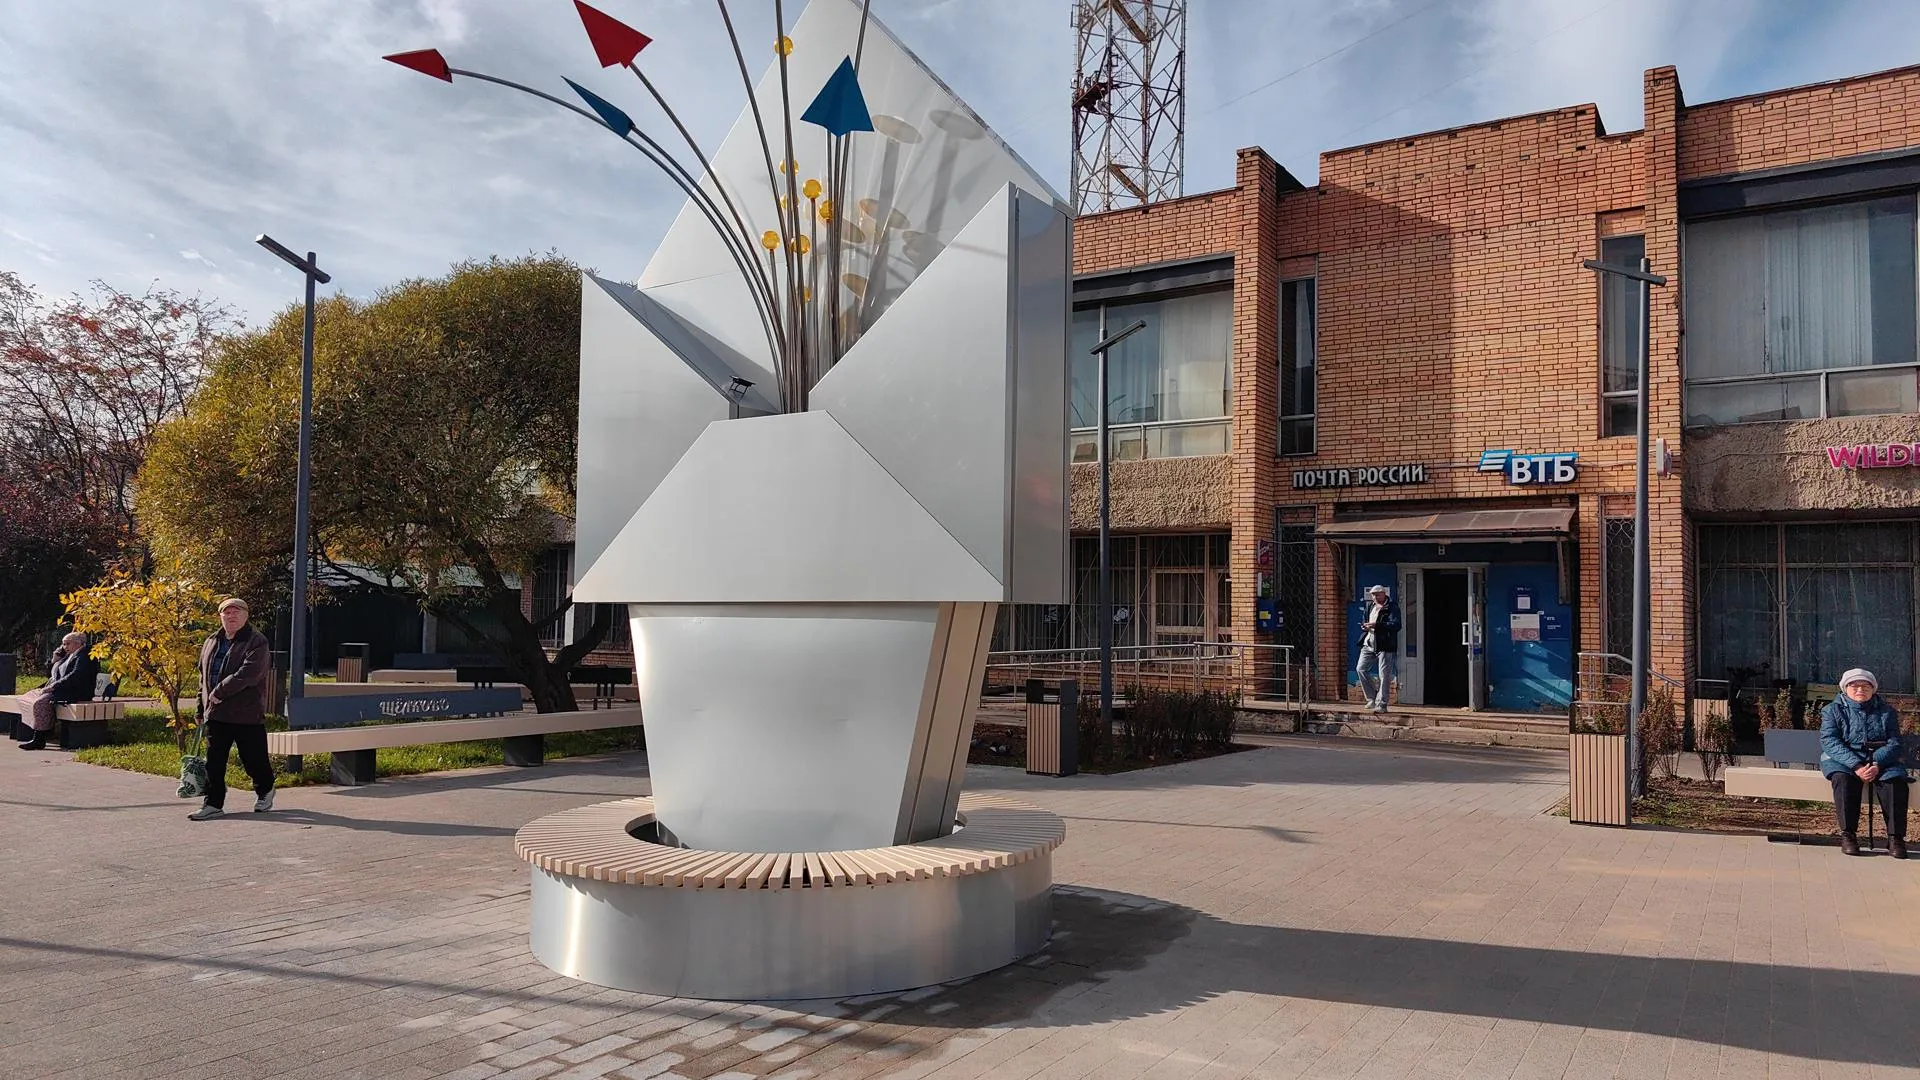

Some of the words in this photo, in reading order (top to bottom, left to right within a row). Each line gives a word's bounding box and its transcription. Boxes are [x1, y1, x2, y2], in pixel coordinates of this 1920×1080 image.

[1292, 469, 1350, 488] ПОЧТА
[1358, 464, 1424, 485] РОССИИ
[1511, 456, 1576, 484] ВТБ
